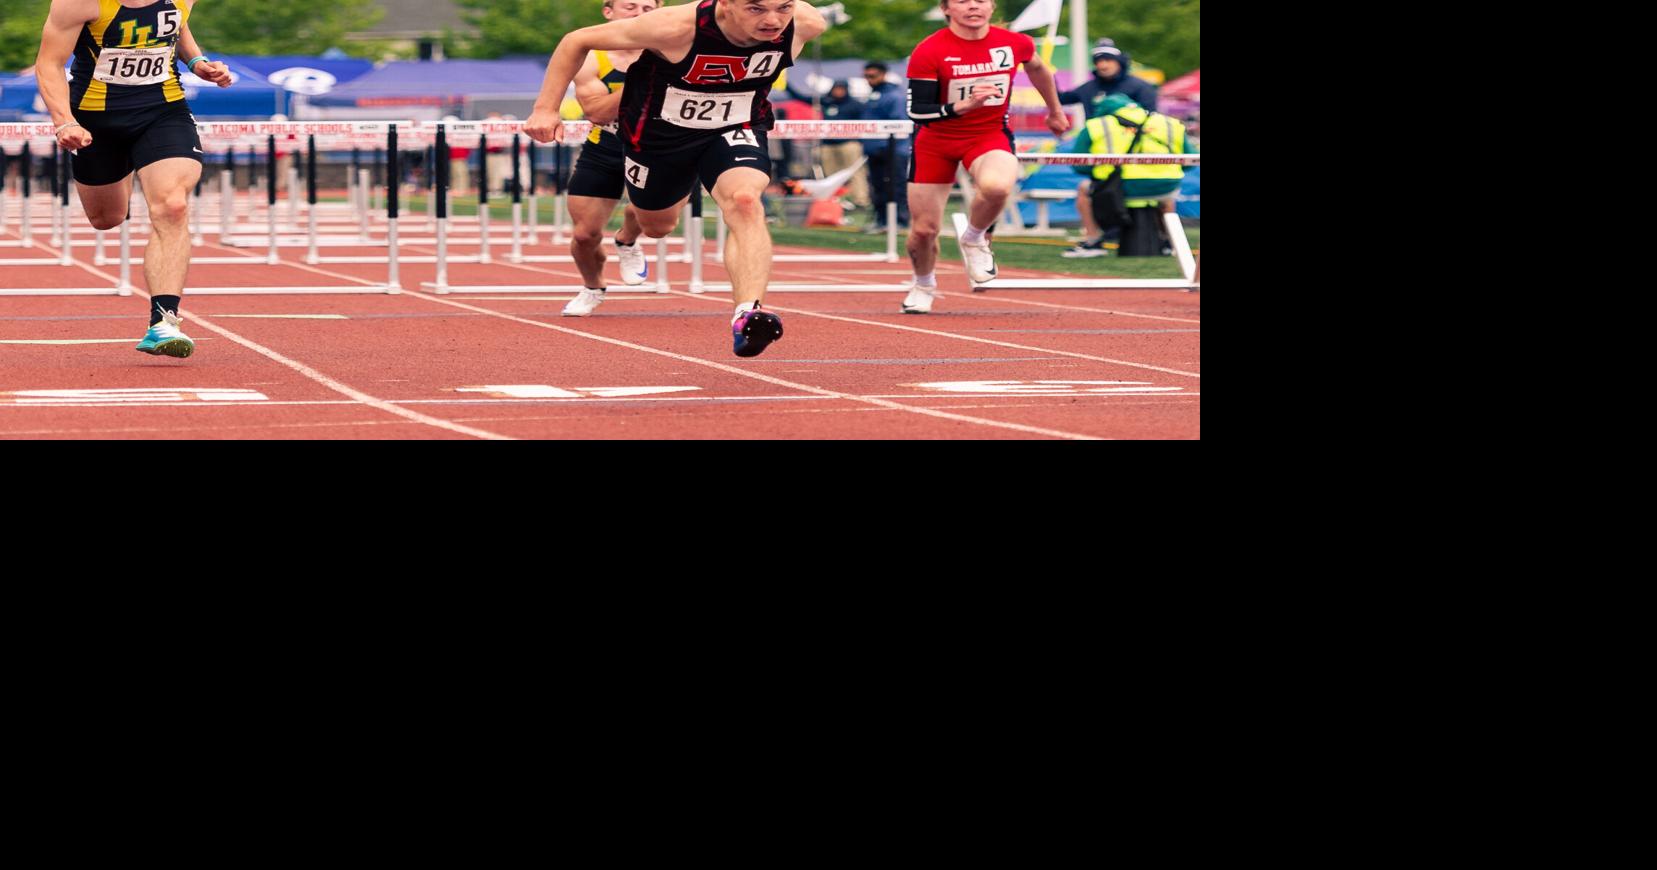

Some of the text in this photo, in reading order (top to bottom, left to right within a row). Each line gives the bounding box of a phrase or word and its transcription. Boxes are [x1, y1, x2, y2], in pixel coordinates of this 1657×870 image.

[163, 12, 177, 35] 5
[108, 57, 164, 78] 1508
[752, 55, 774, 76] 4
[995, 49, 1010, 67] 2
[680, 99, 733, 121] 621
[211, 124, 255, 134] TACOMA
[260, 124, 300, 134] PUBLIC
[304, 124, 353, 134] SCHOOLS
[628, 165, 640, 184] 4
